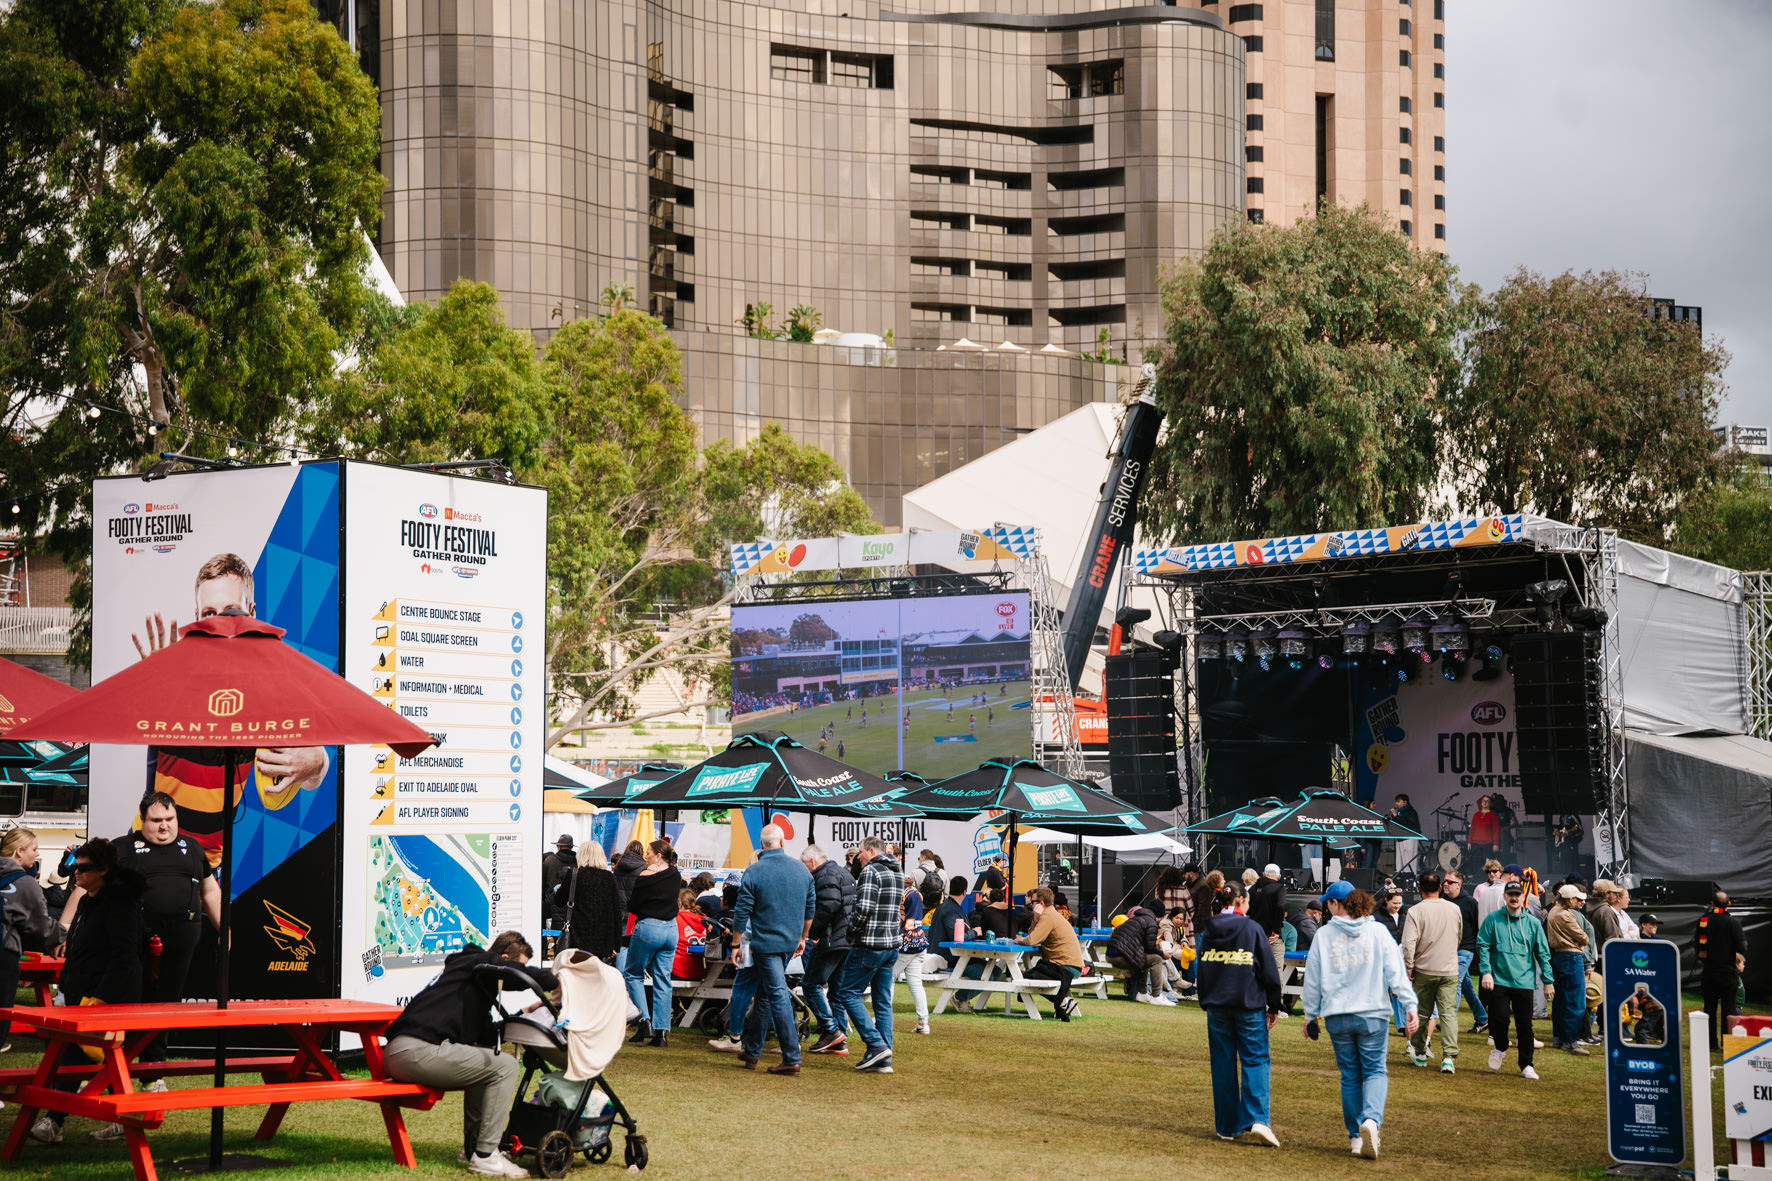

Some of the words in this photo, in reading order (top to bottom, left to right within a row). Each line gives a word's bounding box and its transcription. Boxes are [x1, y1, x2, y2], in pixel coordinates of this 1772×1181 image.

[1108, 459, 1141, 528] SERVICES
[154, 502, 179, 511] Macca's
[421, 506, 437, 517] AFL
[453, 510, 482, 522] Macca's
[109, 517, 142, 538] FOOTY
[146, 514, 193, 535] FESTIVAL
[118, 537, 152, 545] GATHER
[153, 535, 183, 543] ROUND
[401, 519, 441, 550] FOOTY
[444, 525, 498, 557] FESTIVAL
[961, 533, 979, 543] GATHER
[863, 541, 894, 559] Kayo
[413, 550, 452, 562] GATHER
[453, 554, 486, 565] ROUND
[1089, 533, 1116, 589] CRANE
[400, 605, 428, 618] CENTRE
[430, 608, 458, 621] BOUNCE
[460, 611, 481, 622] STAGE
[400, 630, 419, 642] GOAL
[421, 632, 450, 645] SQUARE
[451, 635, 478, 646] SCREEN
[400, 656, 424, 667] WATER
[400, 680, 447, 694] INFORMATION
[453, 684, 484, 696] MEDICAL
[400, 705, 428, 717] TOILETS
[1368, 697, 1398, 724] GATHER
[1474, 706, 1504, 720] AFL
[136, 720, 219, 733] GRANT
[230, 718, 310, 733] BURGE
[143, 733, 205, 741] HONOURING
[1437, 731, 1513, 774] FOOTY
[399, 757, 412, 767] AFL
[413, 756, 464, 768] MERCHANDISE
[697, 770, 742, 792] PIRATE
[793, 775, 820, 788] South
[817, 770, 853, 787] Coast
[399, 782, 414, 792] EXIT
[416, 782, 425, 792] TO
[426, 782, 460, 793] ADELAIDE
[461, 782, 479, 793] OVAL
[801, 786, 834, 798] PALE
[832, 780, 864, 797] ALE
[930, 787, 964, 797] South
[965, 788, 996, 797] Coast
[398, 807, 412, 818] AFL
[413, 807, 440, 818] PLAYER
[440, 807, 469, 818] SIGNING
[868, 803, 893, 811] ALE
[1297, 815, 1341, 825] South
[1341, 815, 1384, 825] Coast
[832, 821, 870, 841] FOOTY
[873, 821, 927, 841] FESTVAL
[1299, 823, 1346, 832] PALE
[1349, 824, 1386, 833] ALE
[977, 857, 992, 868] ELDER
[361, 944, 382, 964] GATHER
[267, 961, 309, 971] ADELAIDE
[1624, 967, 1635, 976] SA
[1635, 968, 1657, 977] Water
[1628, 1060, 1655, 1070] BYOB
[1628, 1078, 1651, 1086] BRING
[1620, 1085, 1669, 1094] EVERYWHERE
